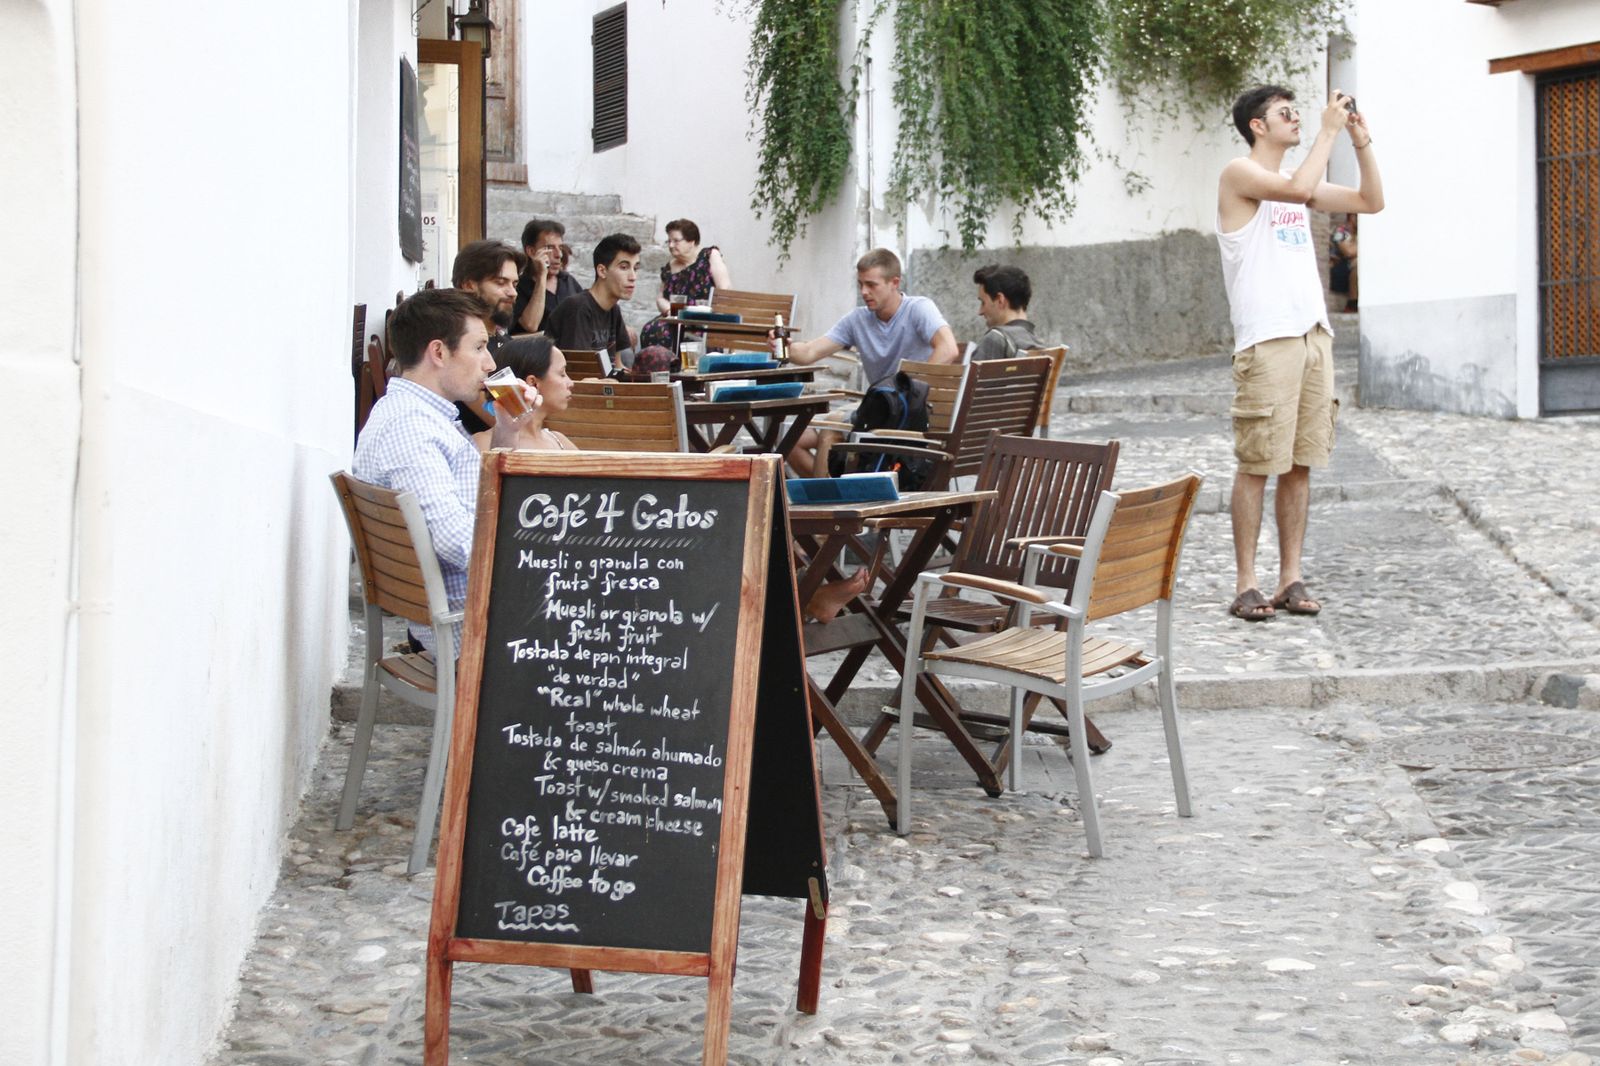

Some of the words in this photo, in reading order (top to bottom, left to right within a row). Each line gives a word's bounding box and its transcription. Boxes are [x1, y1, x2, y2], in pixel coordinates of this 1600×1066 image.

[518, 493, 591, 541] Café
[595, 491, 625, 533] 4
[632, 493, 719, 530] Gatos
[517, 550, 569, 570] Muesli
[574, 559, 583, 569] o
[589, 551, 649, 579] granola
[657, 558, 684, 570] con
[545, 571, 589, 598] fruta
[601, 572, 660, 595] fresca
[545, 599, 596, 621] Muesli
[600, 609, 620, 621] or
[622, 599, 684, 625] granola
[692, 602, 721, 633] w/
[567, 620, 611, 646] fresh
[617, 624, 663, 651] fruit
[506, 638, 569, 663] Tostada
[574, 644, 590, 660] de
[593, 652, 620, 668] pan
[626, 647, 688, 674] integral
[603, 694, 645, 713] whole
[650, 694, 701, 720] wheat
[565, 711, 617, 735] toast
[502, 723, 562, 748] Tostada
[570, 734, 588, 752] de
[596, 732, 646, 758] salmón
[652, 736, 722, 767] ahumado
[543, 751, 561, 771] &
[566, 757, 609, 776] queso
[612, 763, 668, 781] crema
[534, 775, 584, 796] Toast
[611, 783, 669, 807] smoked
[674, 787, 722, 814] salmon
[553, 815, 599, 843] latte
[565, 800, 587, 822] &
[590, 811, 641, 826] cream
[647, 807, 703, 836] cheese
[500, 841, 542, 871] Café
[545, 849, 582, 866] para
[589, 846, 639, 867] llevar
[527, 865, 583, 895] Coffee
[589, 869, 610, 893] to
[609, 880, 636, 901] go
[494, 901, 570, 922] Tapas
